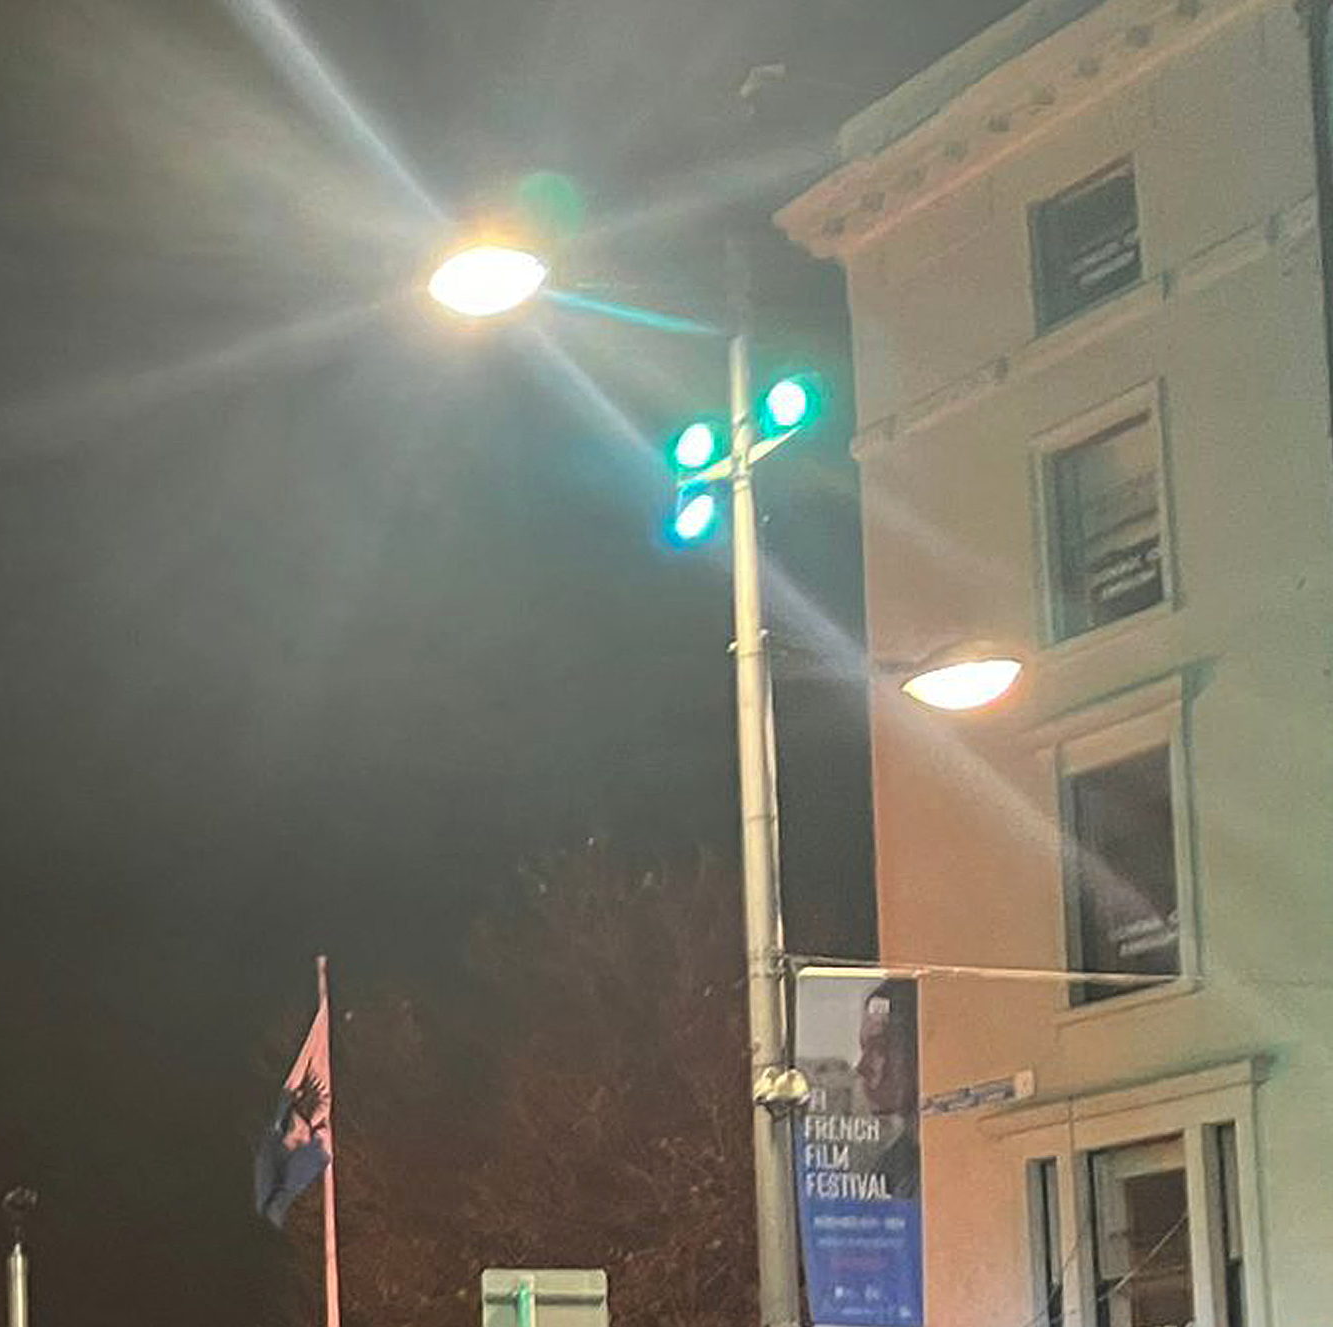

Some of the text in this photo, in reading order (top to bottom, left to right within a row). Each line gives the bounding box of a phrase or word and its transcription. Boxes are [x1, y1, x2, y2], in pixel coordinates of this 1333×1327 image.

[804, 1115, 881, 1142] FRENCH
[804, 1143, 850, 1171] FILM
[805, 1171, 892, 1200] FESTIVAL
